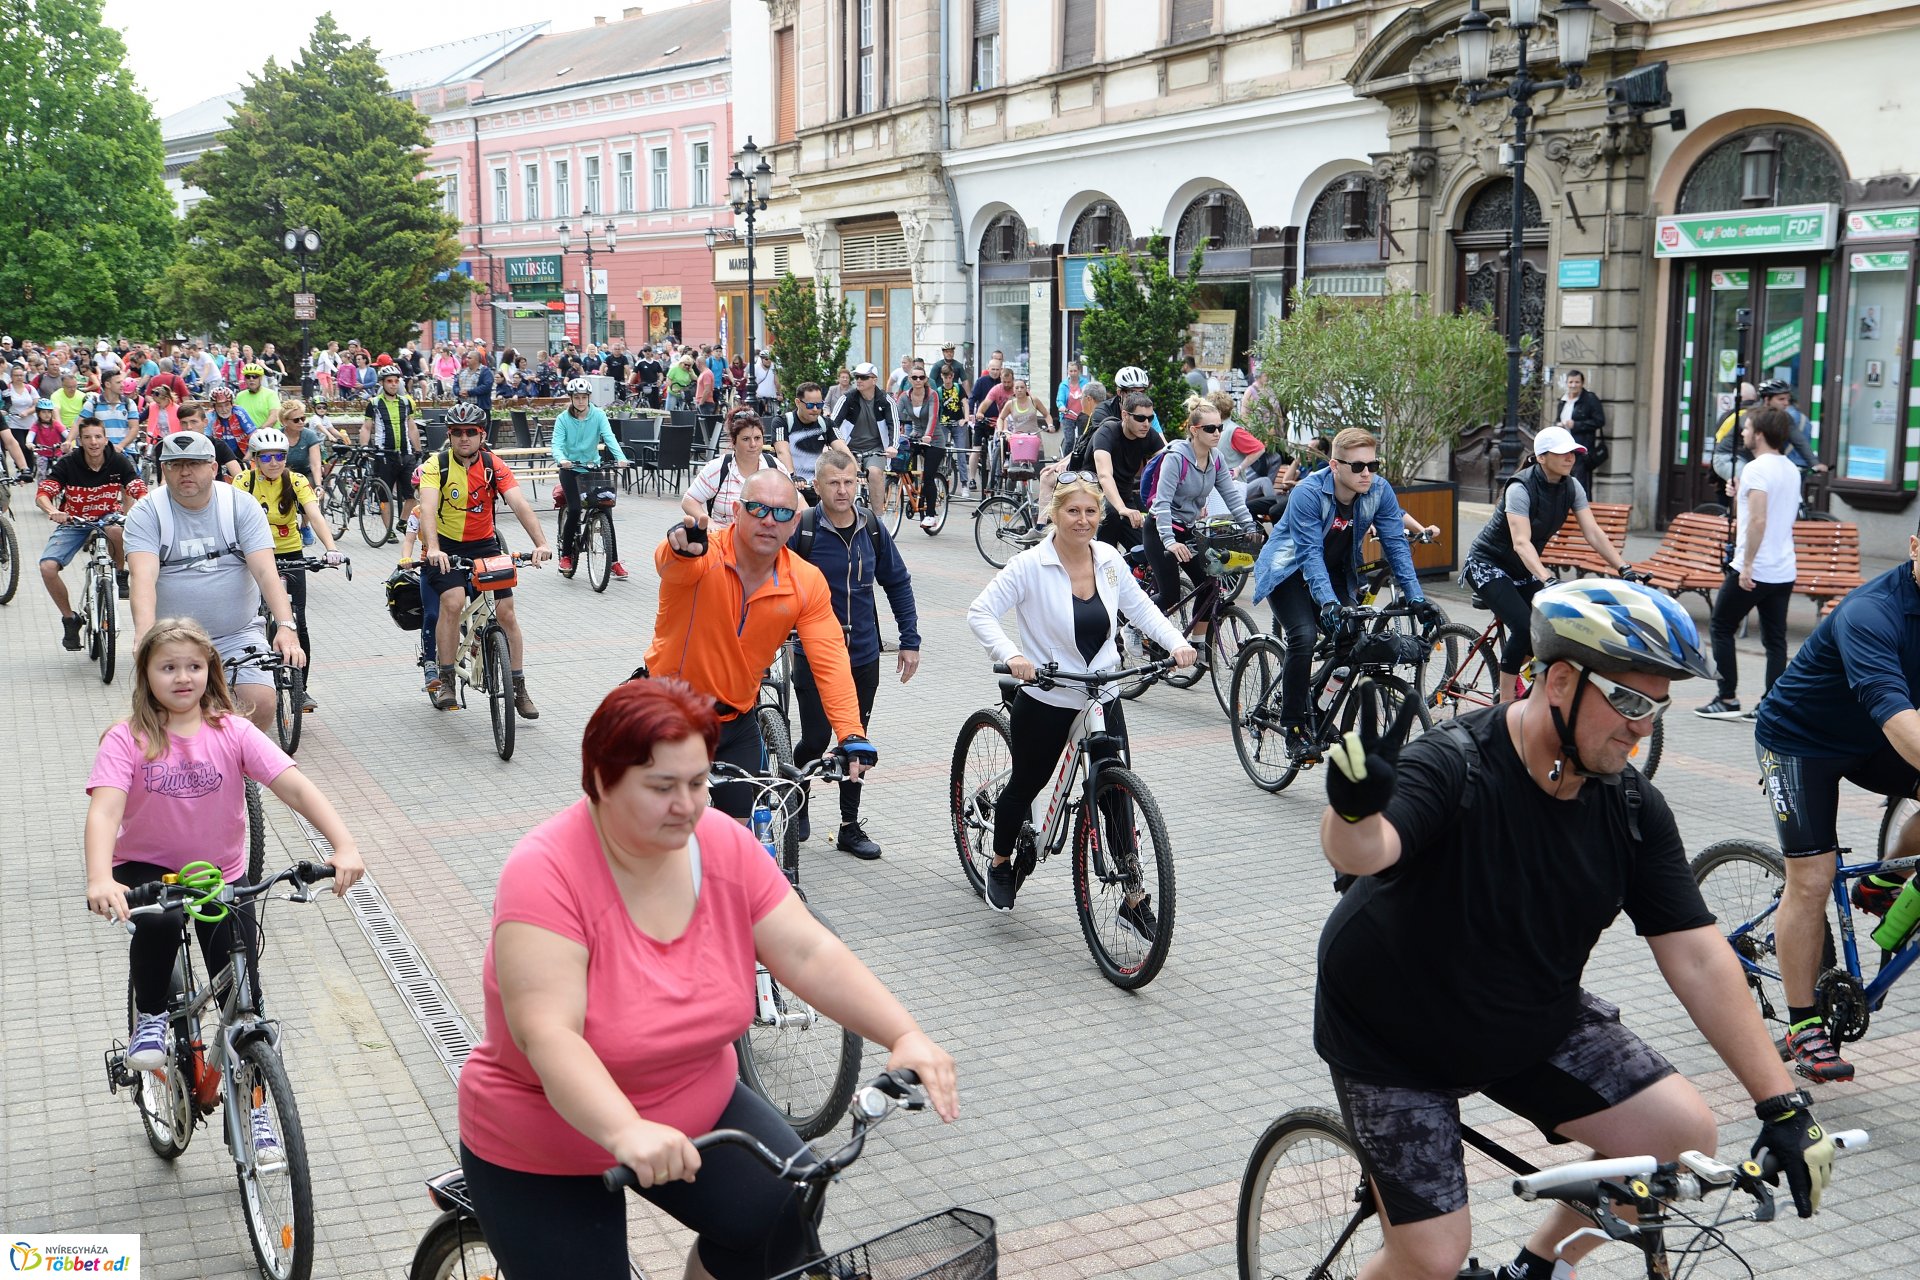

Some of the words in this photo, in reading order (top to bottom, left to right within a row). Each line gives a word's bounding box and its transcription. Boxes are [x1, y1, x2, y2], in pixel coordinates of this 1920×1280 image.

[1786, 218, 1818, 236] FDF
[510, 257, 555, 276] NYÍRSÉG
[82, 502, 110, 513] Black
[141, 762, 220, 793] Princess
